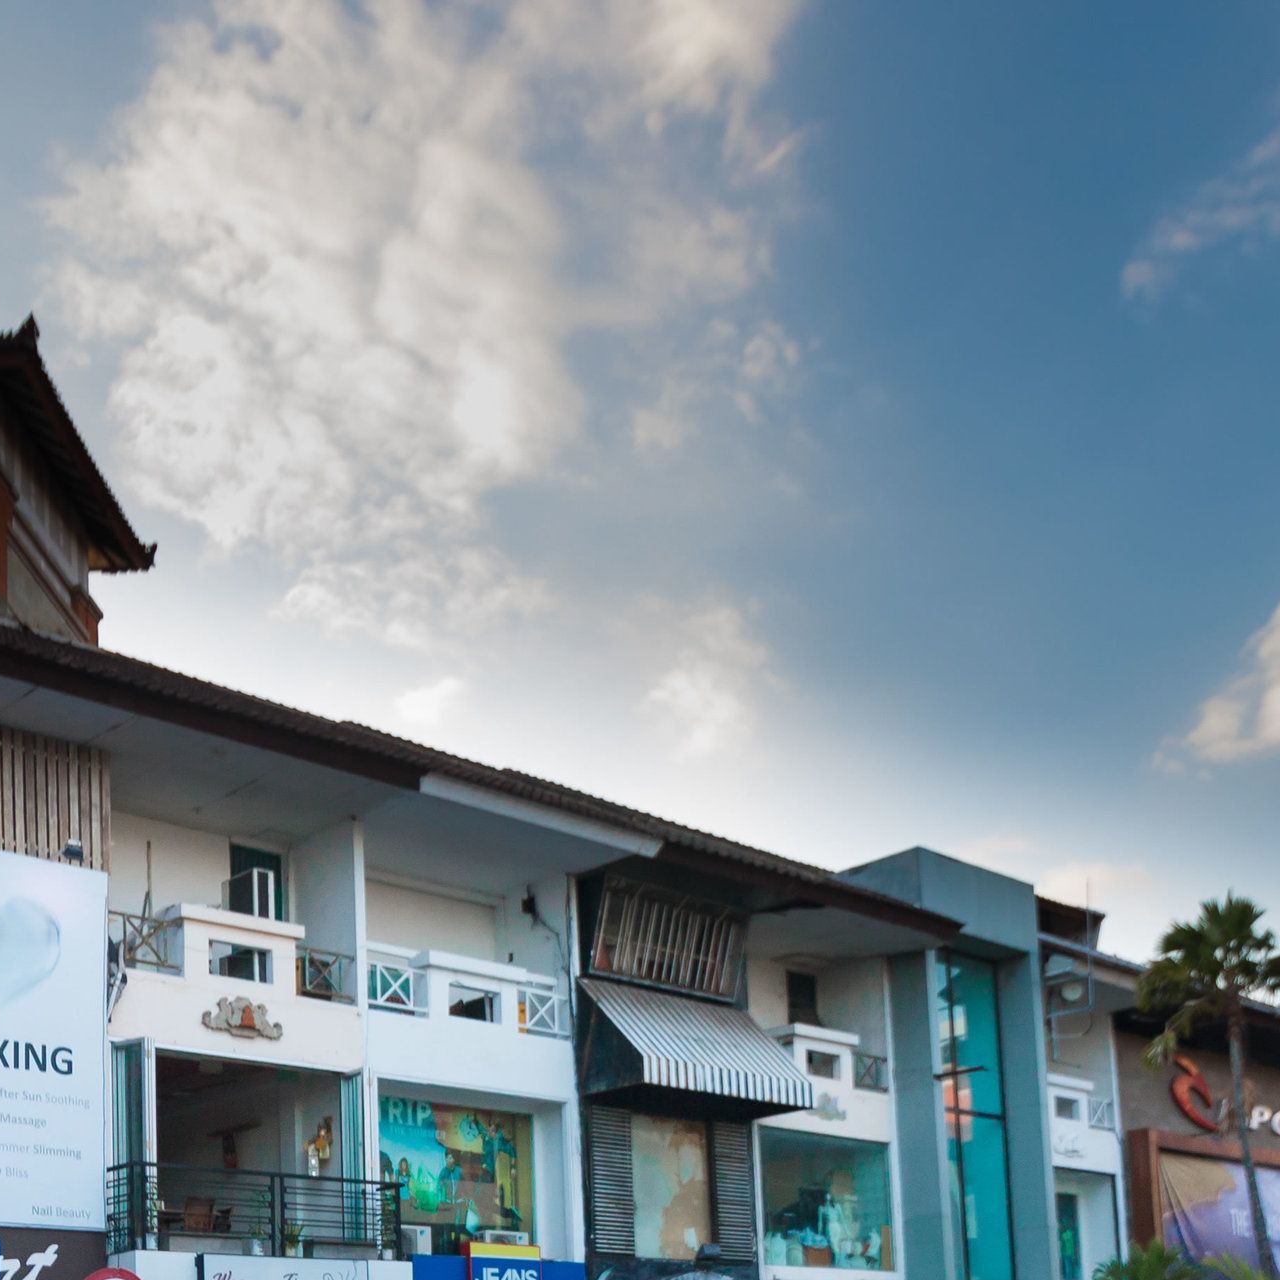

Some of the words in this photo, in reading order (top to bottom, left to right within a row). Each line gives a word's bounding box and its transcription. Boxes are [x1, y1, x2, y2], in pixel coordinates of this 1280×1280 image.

[22, 1091, 42, 1102] Sun
[45, 1093, 91, 1110] Soothing
[0, 1113, 47, 1129] Massage
[32, 1144, 82, 1160] Slimming
[5, 1166, 29, 1179] Bliss
[31, 1205, 53, 1217] Nail
[55, 1206, 92, 1220] Beauty
